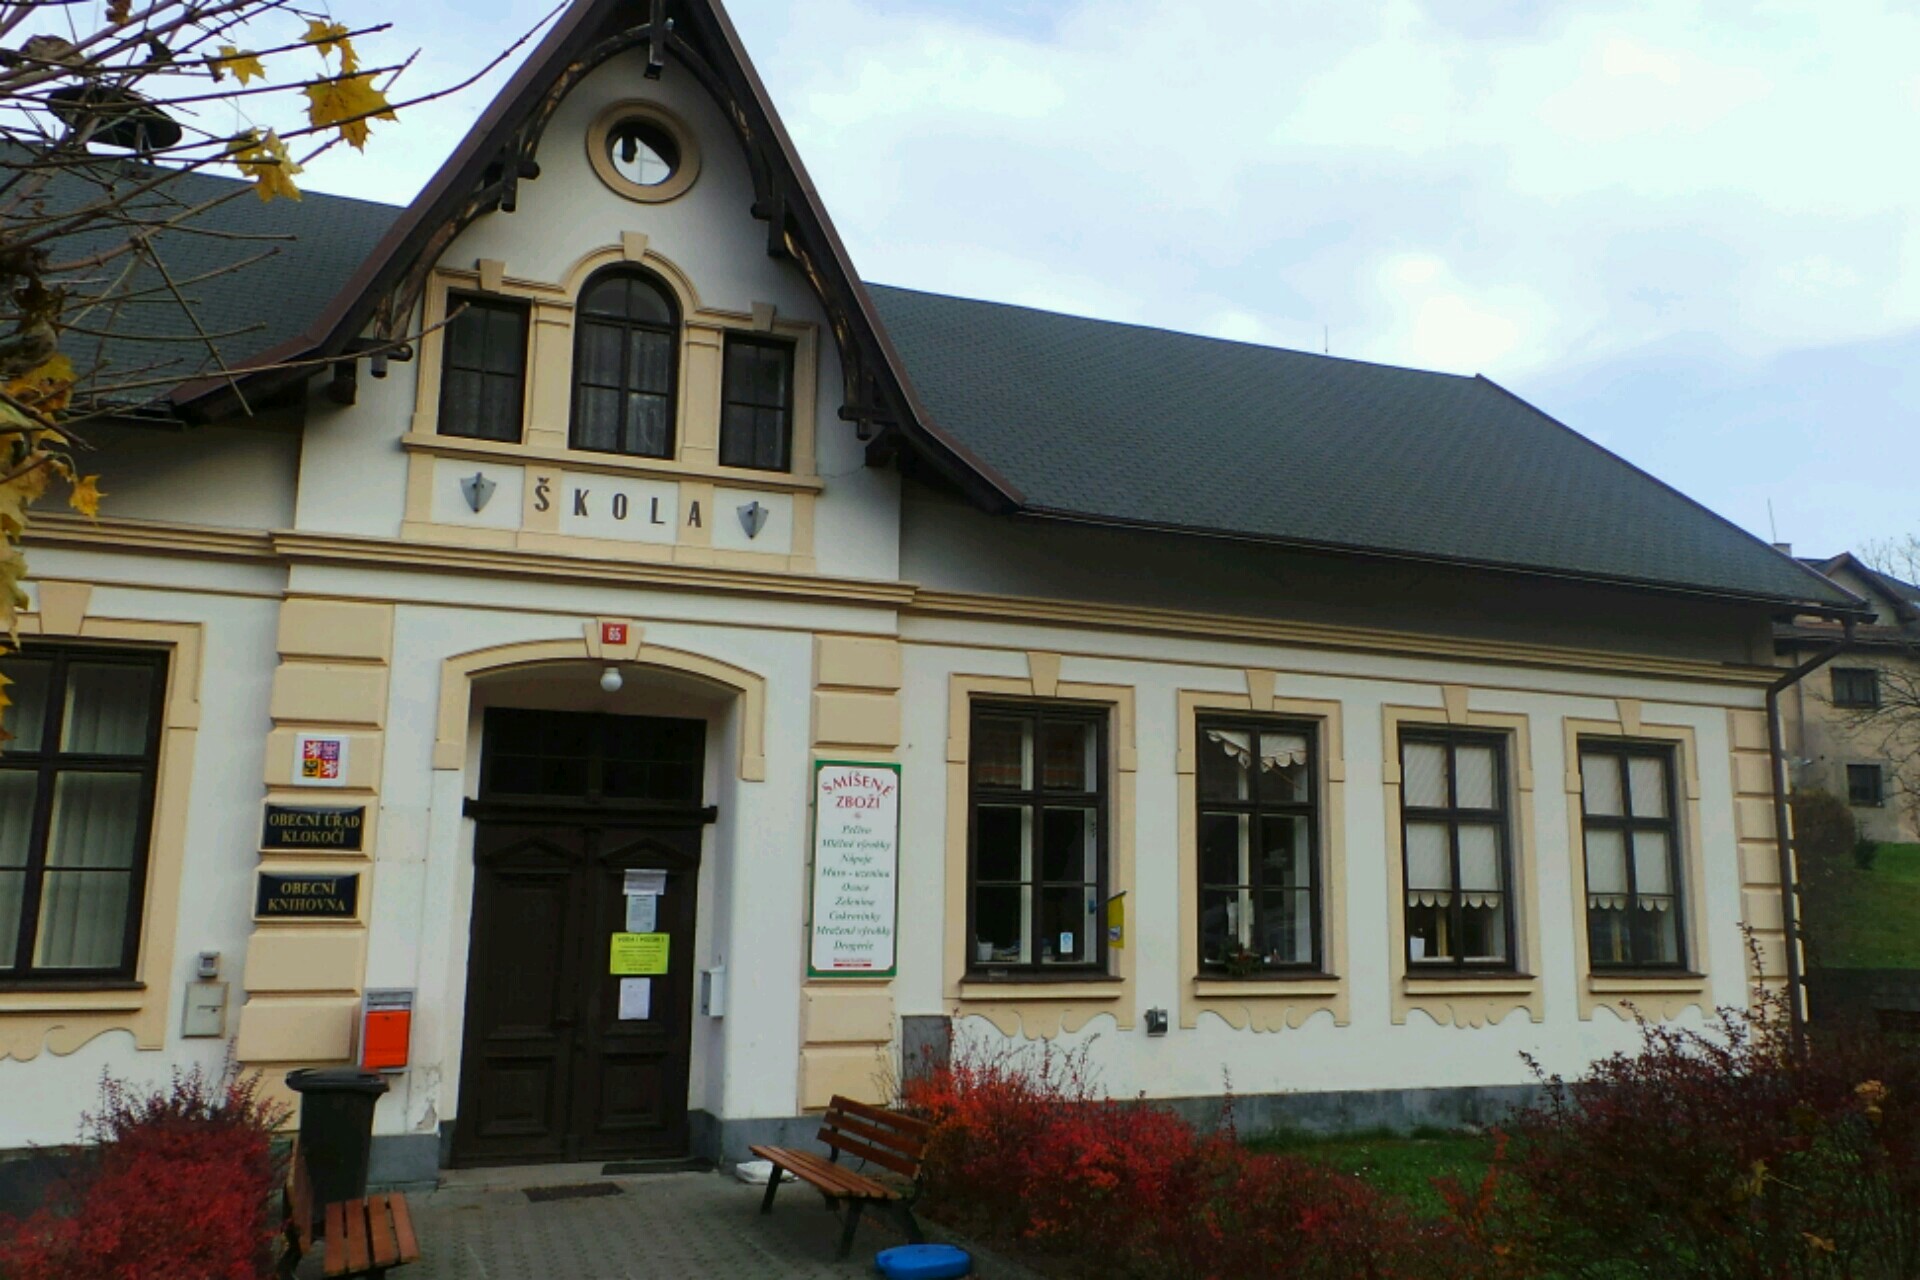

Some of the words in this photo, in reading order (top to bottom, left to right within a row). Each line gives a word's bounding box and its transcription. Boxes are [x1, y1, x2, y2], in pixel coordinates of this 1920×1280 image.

[534, 477, 702, 528] ŠKOLA
[822, 770, 894, 797] SMÍŠENÉ
[836, 793, 881, 809] ZBOŽÍ
[269, 811, 321, 827] OBECNÍ
[325, 811, 360, 828] ÚŘAD
[281, 829, 345, 844] KLOKOČÍ
[281, 879, 338, 895] OBECNÍ
[267, 898, 346, 912] KNIHOVNA
